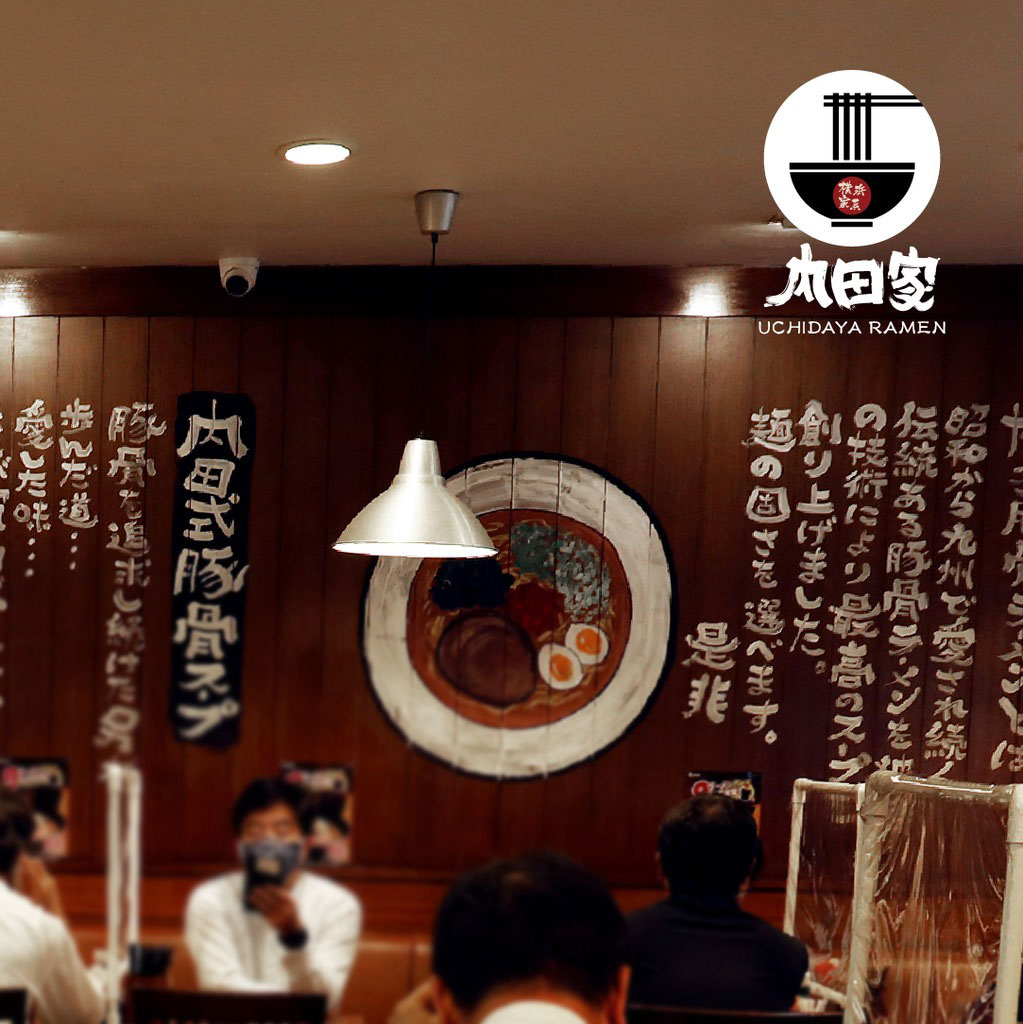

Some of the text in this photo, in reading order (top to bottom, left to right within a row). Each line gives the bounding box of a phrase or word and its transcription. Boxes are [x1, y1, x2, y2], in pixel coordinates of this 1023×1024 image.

[681, 621, 739, 725] 是非
[741, 405, 795, 745] 麺の固さを選べます。
[789, 398, 842, 676] 創り上げました。
